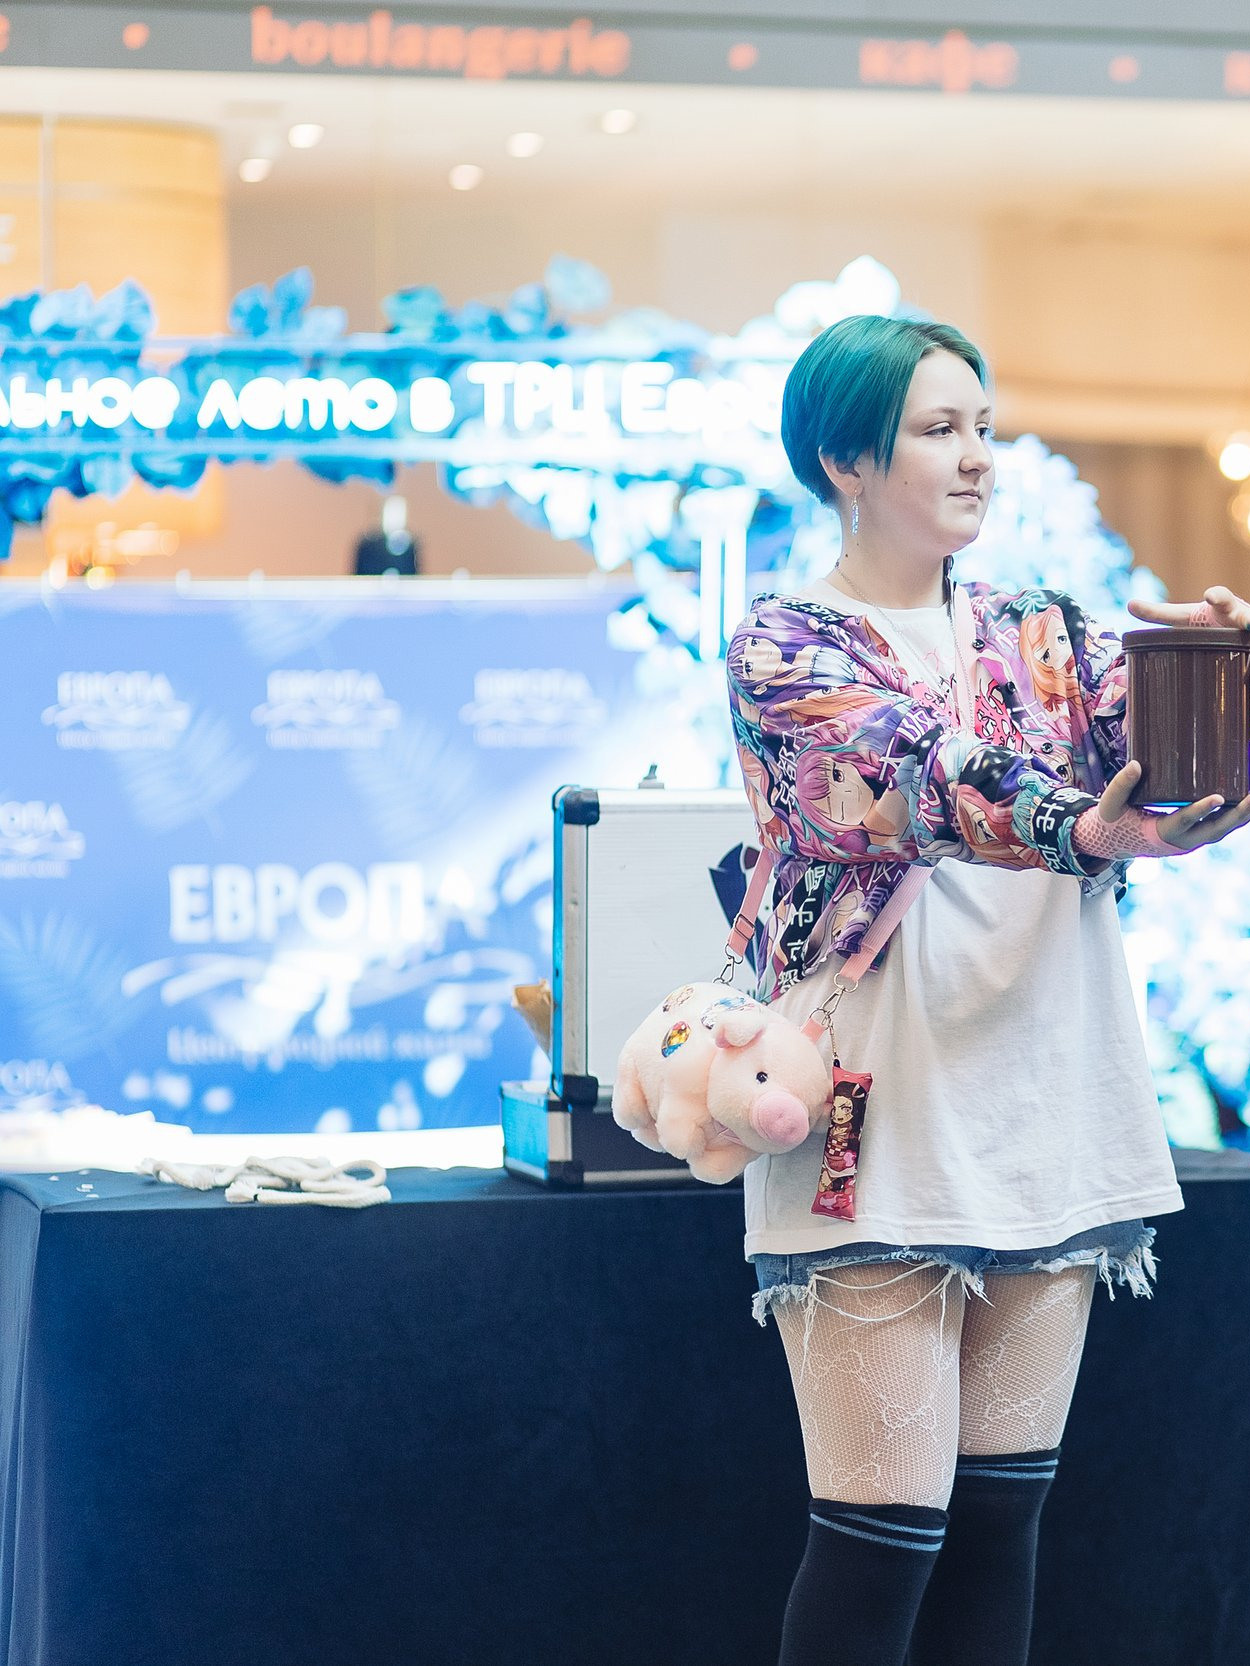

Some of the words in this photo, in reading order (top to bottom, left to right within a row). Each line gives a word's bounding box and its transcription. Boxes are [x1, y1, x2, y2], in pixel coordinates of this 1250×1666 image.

[251, 5, 631, 80] boulangerie
[0, 376, 180, 429] ьное
[197, 376, 398, 431] лето
[410, 376, 455, 432] в
[466, 361, 612, 438] ТРЦ
[168, 861, 491, 944] ЕВРОПА
